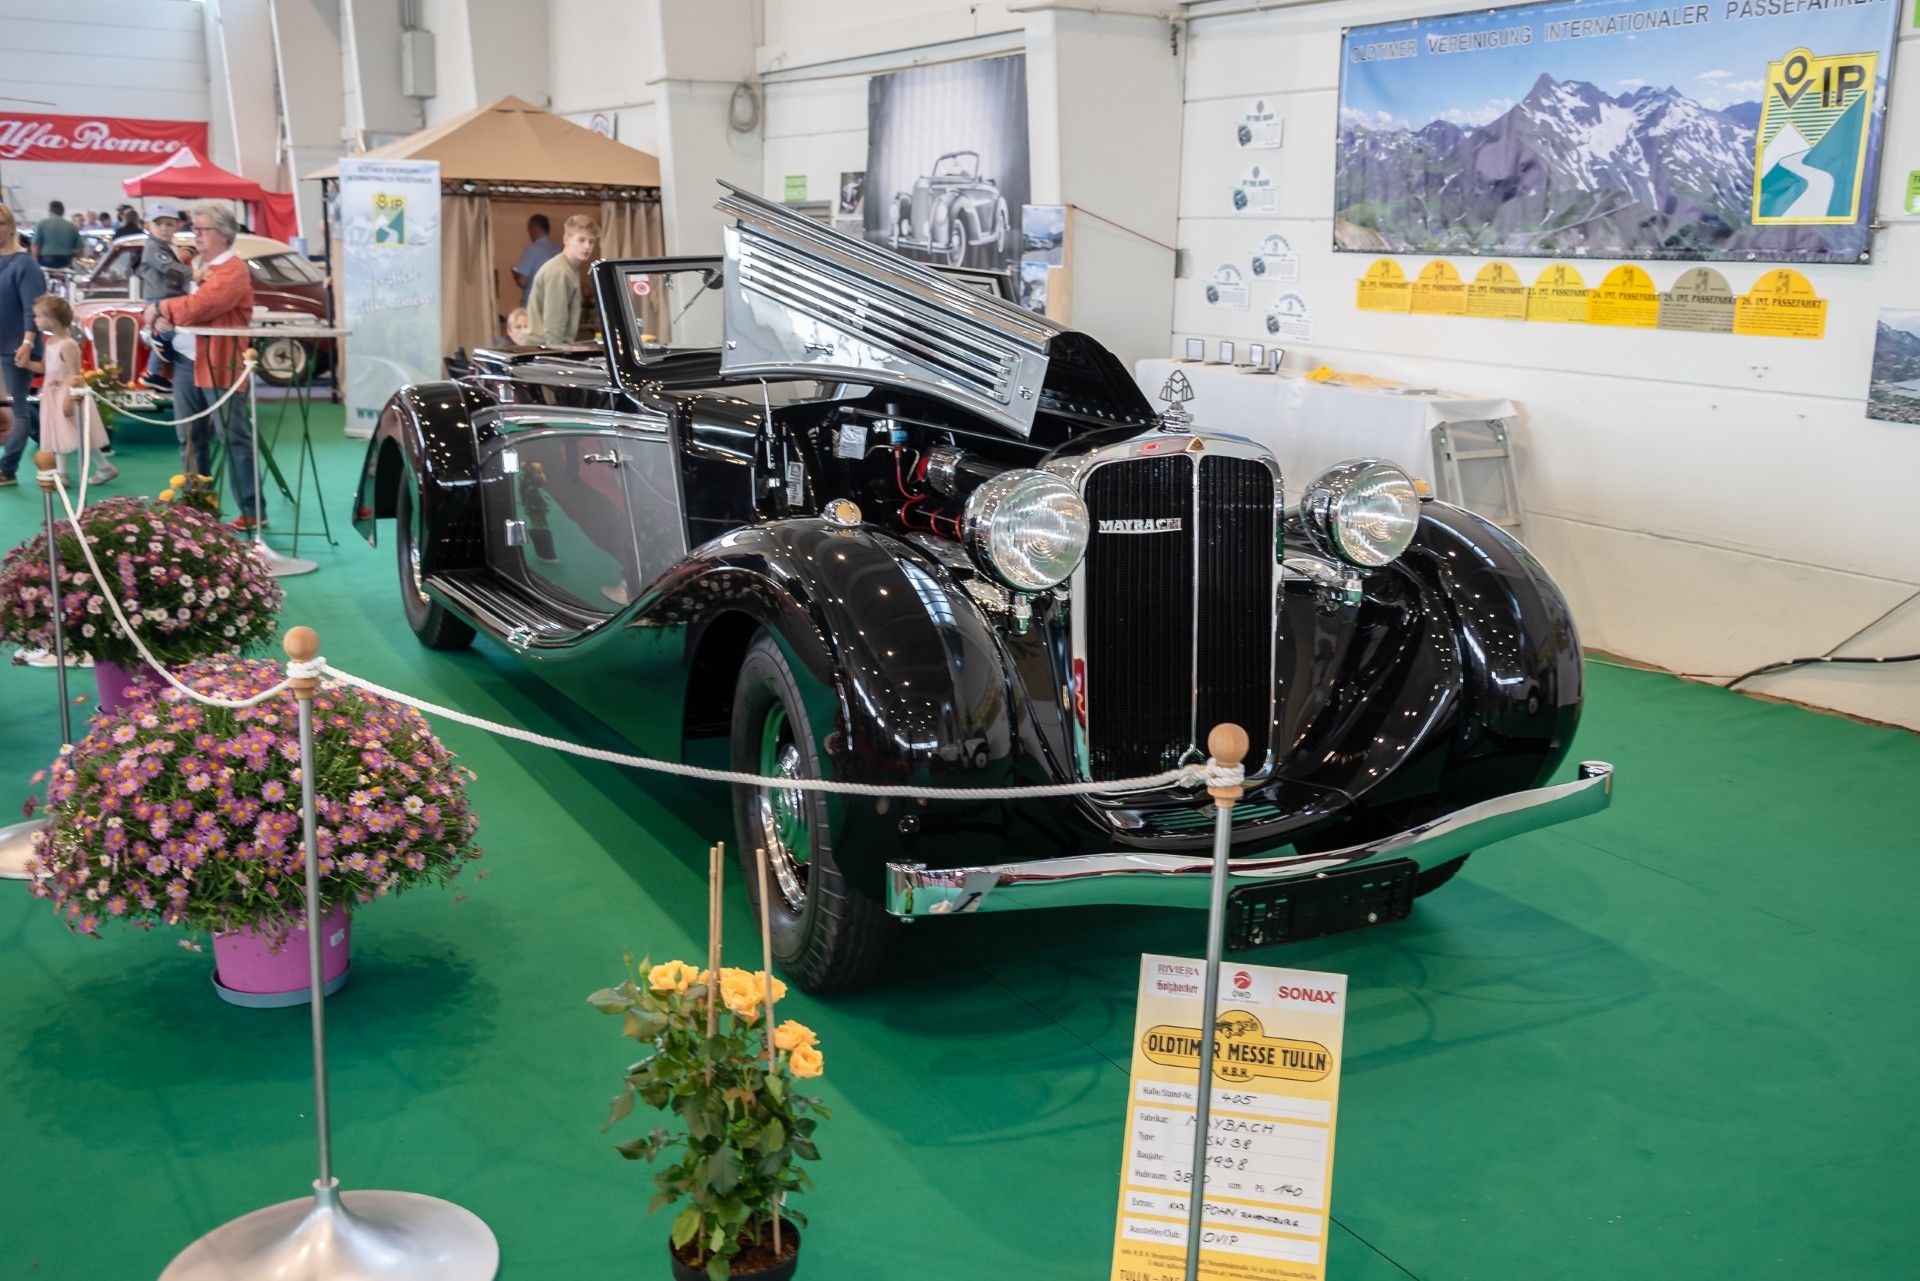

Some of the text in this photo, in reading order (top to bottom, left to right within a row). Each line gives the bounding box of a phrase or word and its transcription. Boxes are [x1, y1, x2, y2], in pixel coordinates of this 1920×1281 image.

[1351, 0, 1884, 63] OLDTIMER VEREINIGUNG INTERNATIONALER PASSEFA
[1098, 517, 1182, 532] MAYBACH
[1278, 985, 1335, 1004] SONAX
[1148, 1034, 1326, 1071] OLDTIMR MESSE TULLN
[1222, 1093, 1257, 1105] 405
[1185, 1115, 1275, 1134] MYBACH
